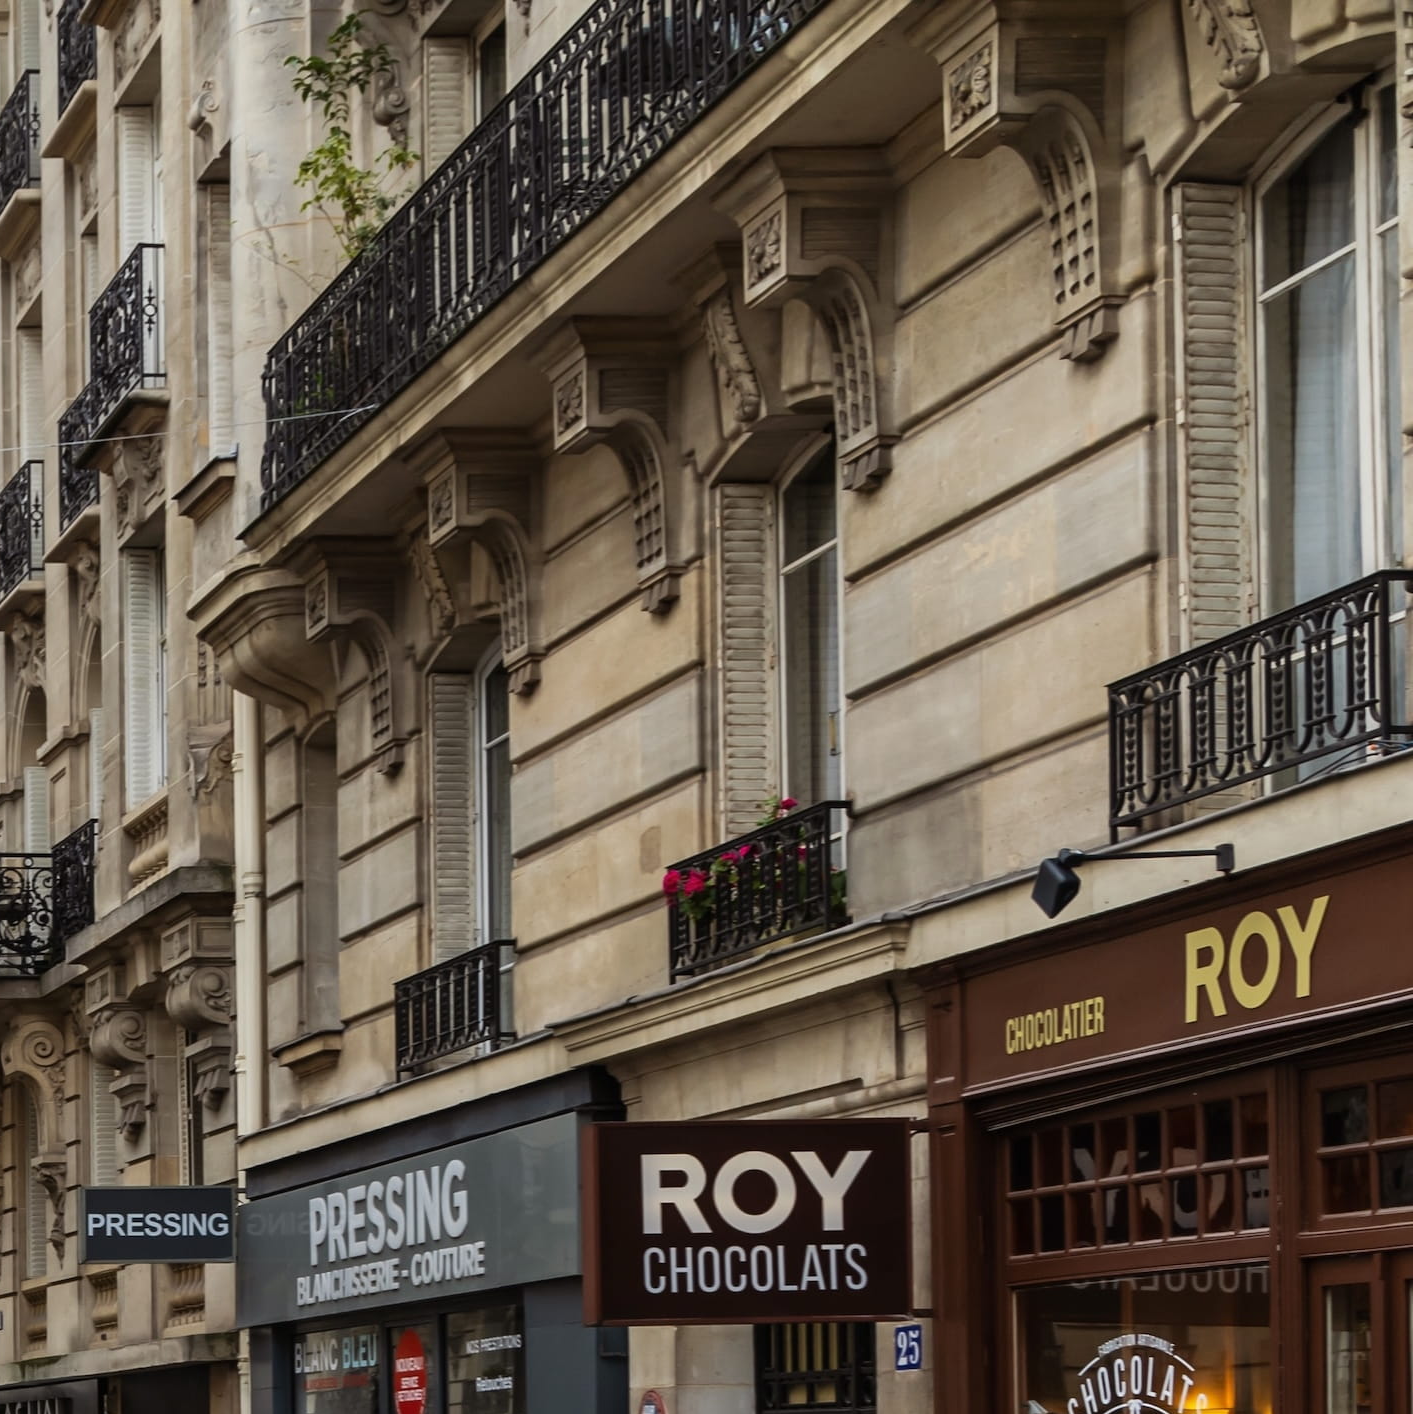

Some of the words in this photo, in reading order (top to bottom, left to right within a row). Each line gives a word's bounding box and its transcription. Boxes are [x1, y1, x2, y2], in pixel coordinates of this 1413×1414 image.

[1185, 895, 1329, 1023] ROY
[1006, 997, 1105, 1055] CHOCOLATIER
[309, 1159, 469, 1266] PRESSING
[640, 1150, 872, 1234] ROY
[87, 1213, 230, 1238] PRESSING
[297, 1258, 400, 1306] BLANCHISSERIE
[411, 1241, 485, 1286] COUTURE
[643, 1244, 868, 1293] CHOCOLATS
[295, 1338, 338, 1373] BLANC
[342, 1334, 377, 1369] BLEU
[897, 1331, 920, 1367] 25
